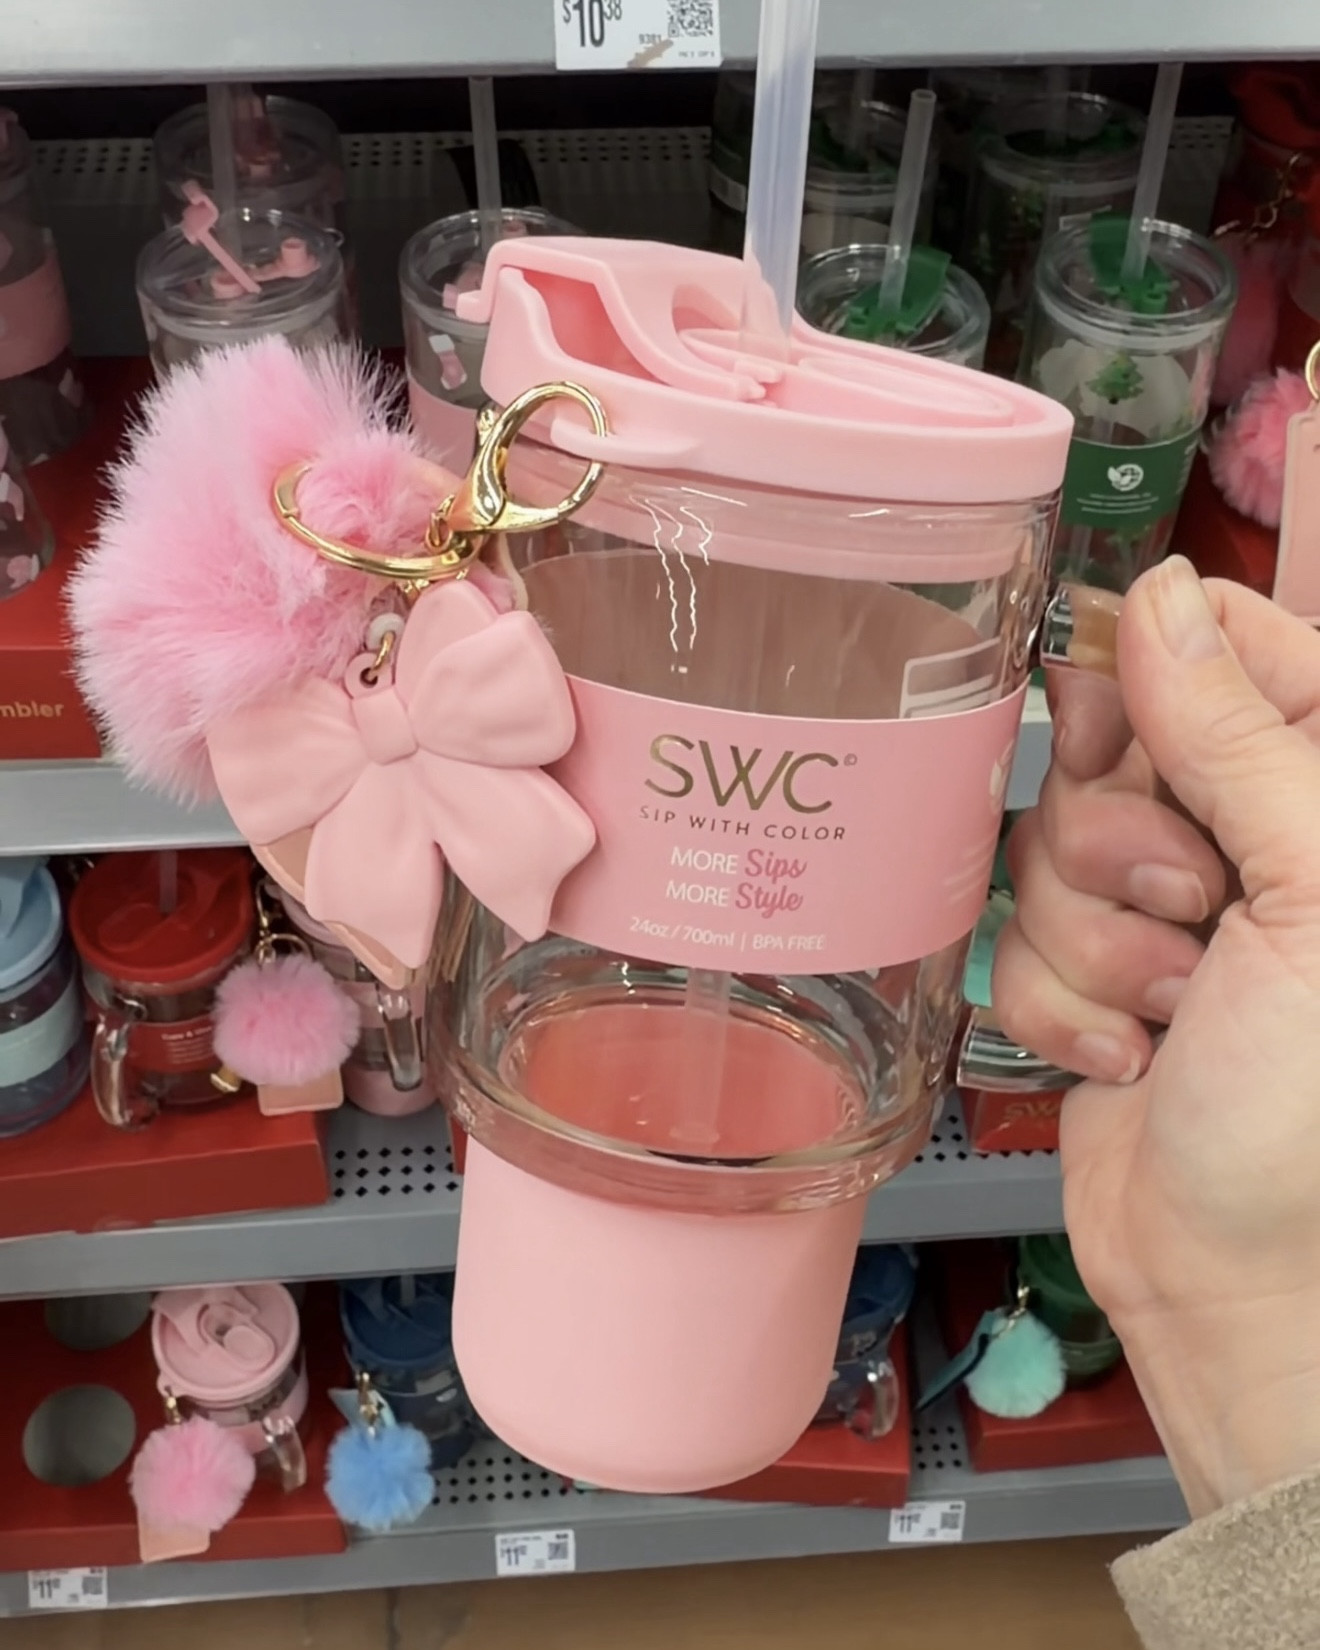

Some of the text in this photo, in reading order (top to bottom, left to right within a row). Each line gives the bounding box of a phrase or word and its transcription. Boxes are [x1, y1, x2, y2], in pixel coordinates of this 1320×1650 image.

[639, 805, 846, 841] SIP WITH COLOR
[671, 846, 807, 884] MORE Sips
[666, 880, 803, 919] MORE Style
[752, 934, 784, 950] BPA
[787, 935, 826, 950] FREE
